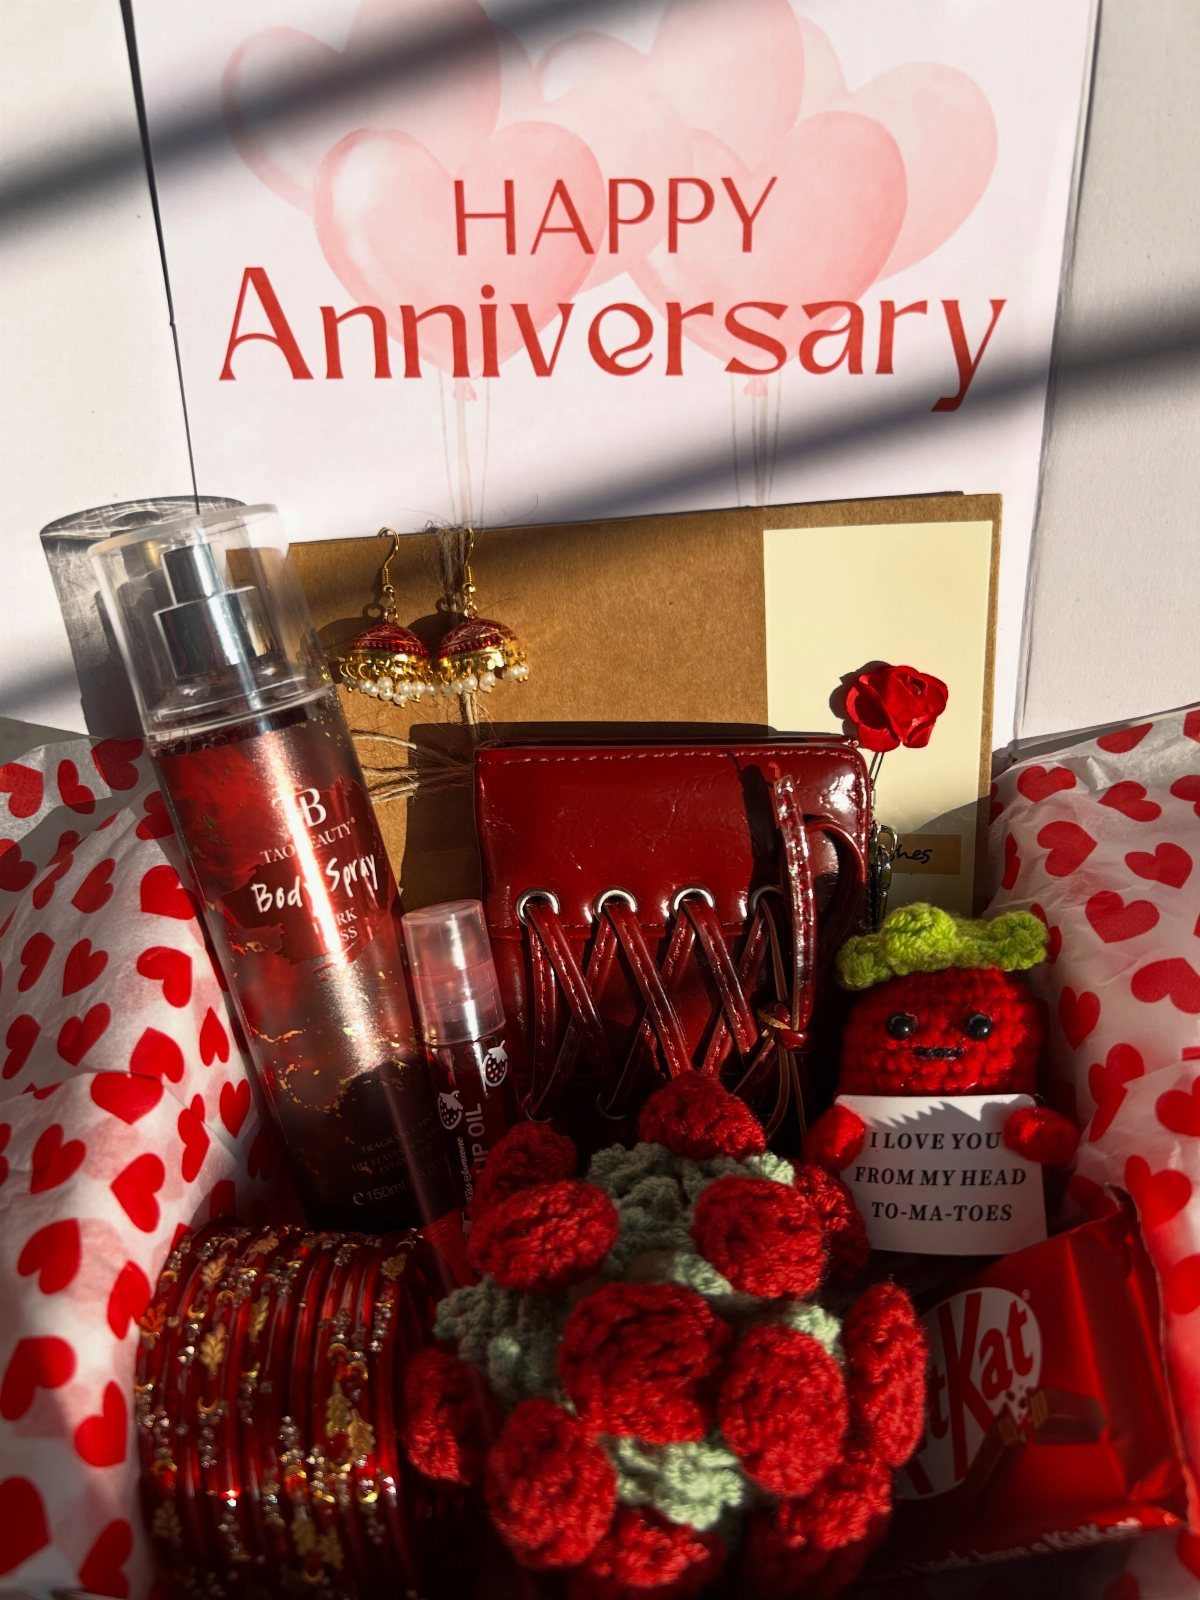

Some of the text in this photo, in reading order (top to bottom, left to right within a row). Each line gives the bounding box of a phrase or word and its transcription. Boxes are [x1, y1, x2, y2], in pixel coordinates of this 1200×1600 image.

[454, 176, 778, 256] HAPPY
[219, 266, 1007, 412] Anniversary
[325, 853, 378, 898] Spray
[465, 1103, 486, 1137] OIL
[869, 1131, 1002, 1150] I LOVE YOU
[854, 1166, 1027, 1187] FROM MY HEAD
[871, 1201, 1013, 1222] TO-MA-TOES
